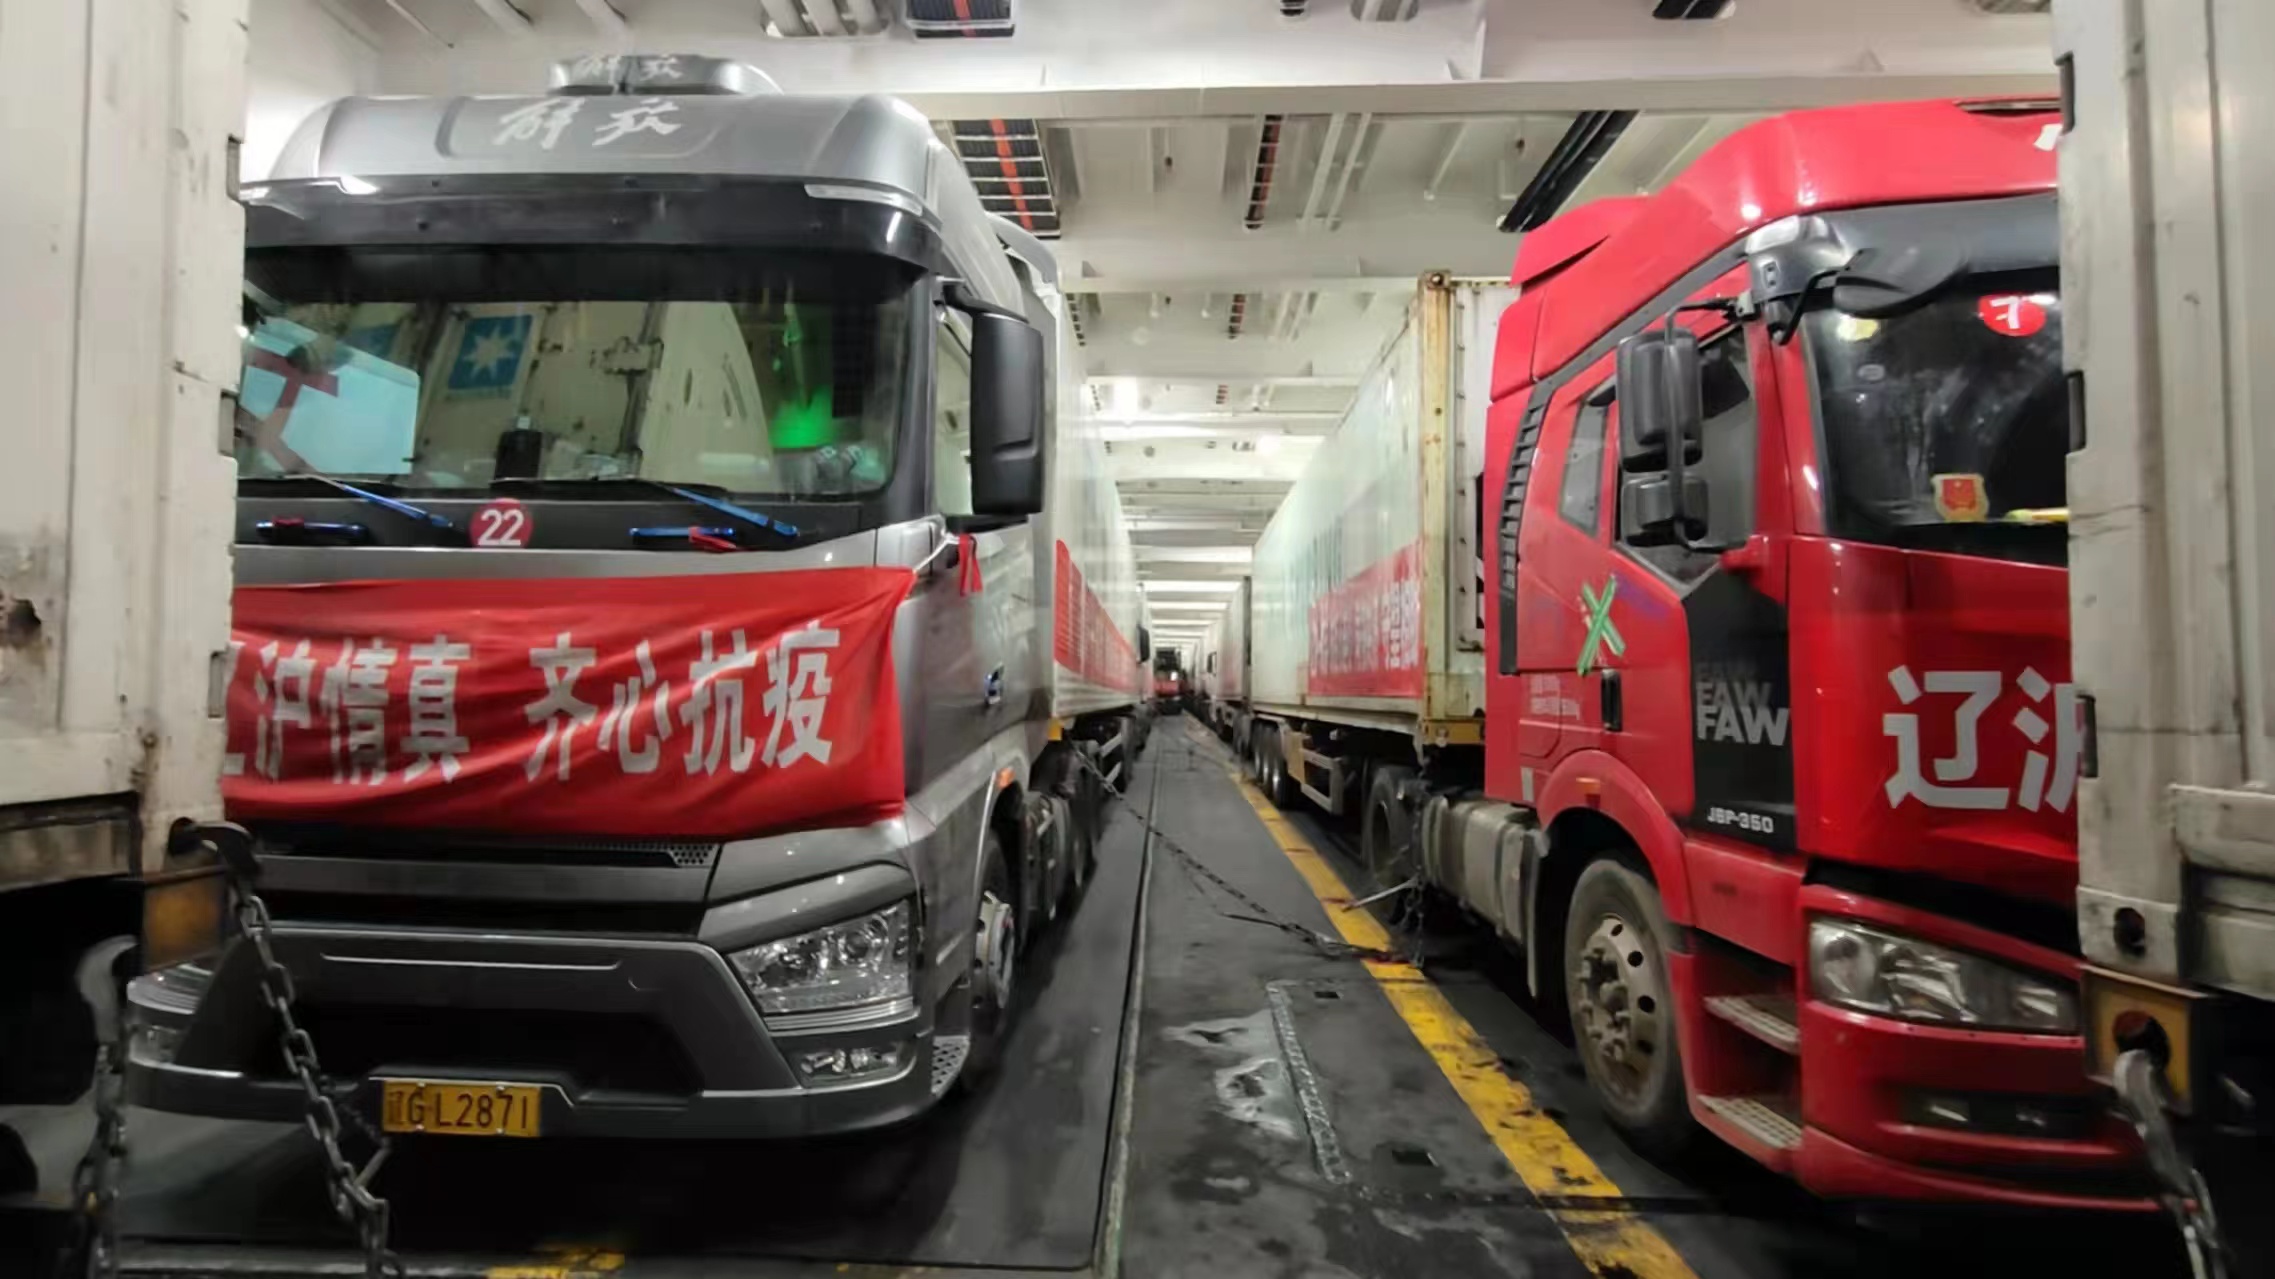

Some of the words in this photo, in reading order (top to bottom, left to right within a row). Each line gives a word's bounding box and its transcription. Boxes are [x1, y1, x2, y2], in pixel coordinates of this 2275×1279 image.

[493, 97, 682, 149] 解放
[478, 509, 524, 546] 22
[525, 619, 840, 782] 齐心抗疫
[1696, 705, 1790, 746] FAW
